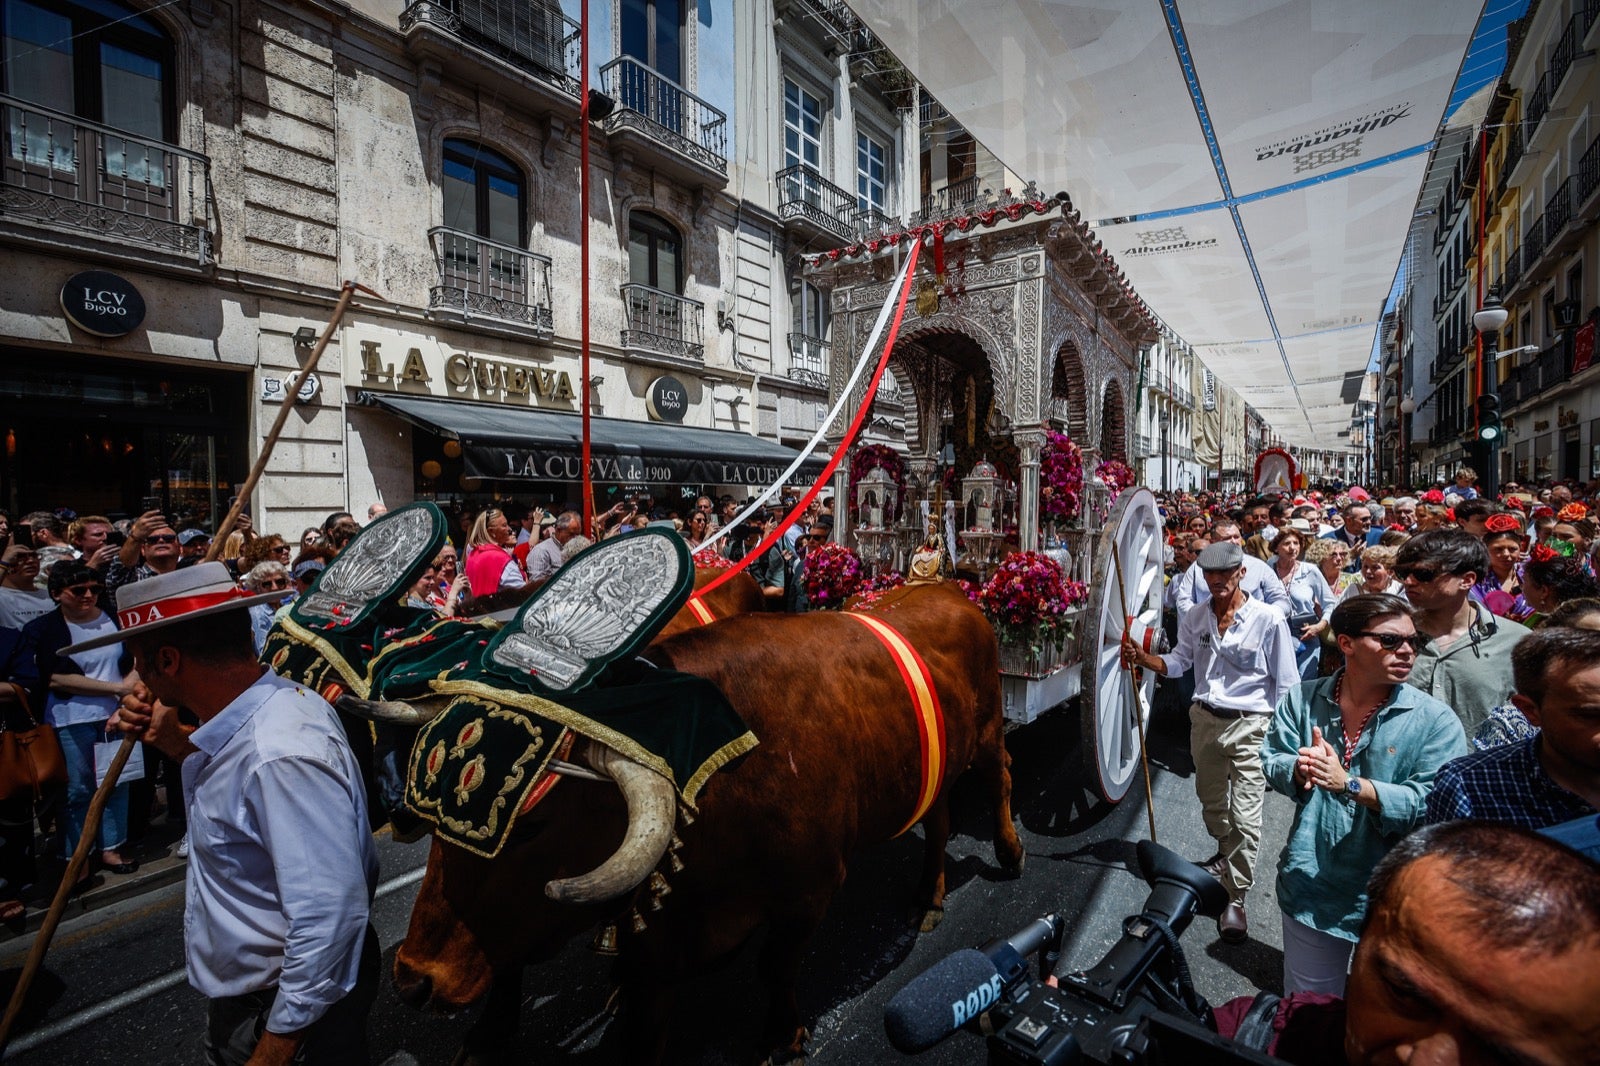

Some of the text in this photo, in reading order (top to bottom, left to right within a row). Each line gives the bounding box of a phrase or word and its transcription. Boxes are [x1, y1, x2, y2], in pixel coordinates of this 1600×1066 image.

[1256, 104, 1416, 162] Alhambra
[1120, 238, 1217, 256] Alhambra
[84, 287, 126, 306] LCV
[360, 340, 578, 400] LA CUEVA
[661, 389, 681, 401] LCV
[505, 452, 540, 477] LA
[627, 464, 643, 480] de
[643, 466, 672, 481] 1900
[721, 464, 744, 483] LA
[793, 474, 804, 485] de
[118, 605, 165, 629] DA
[951, 972, 1002, 1029] RØDE
